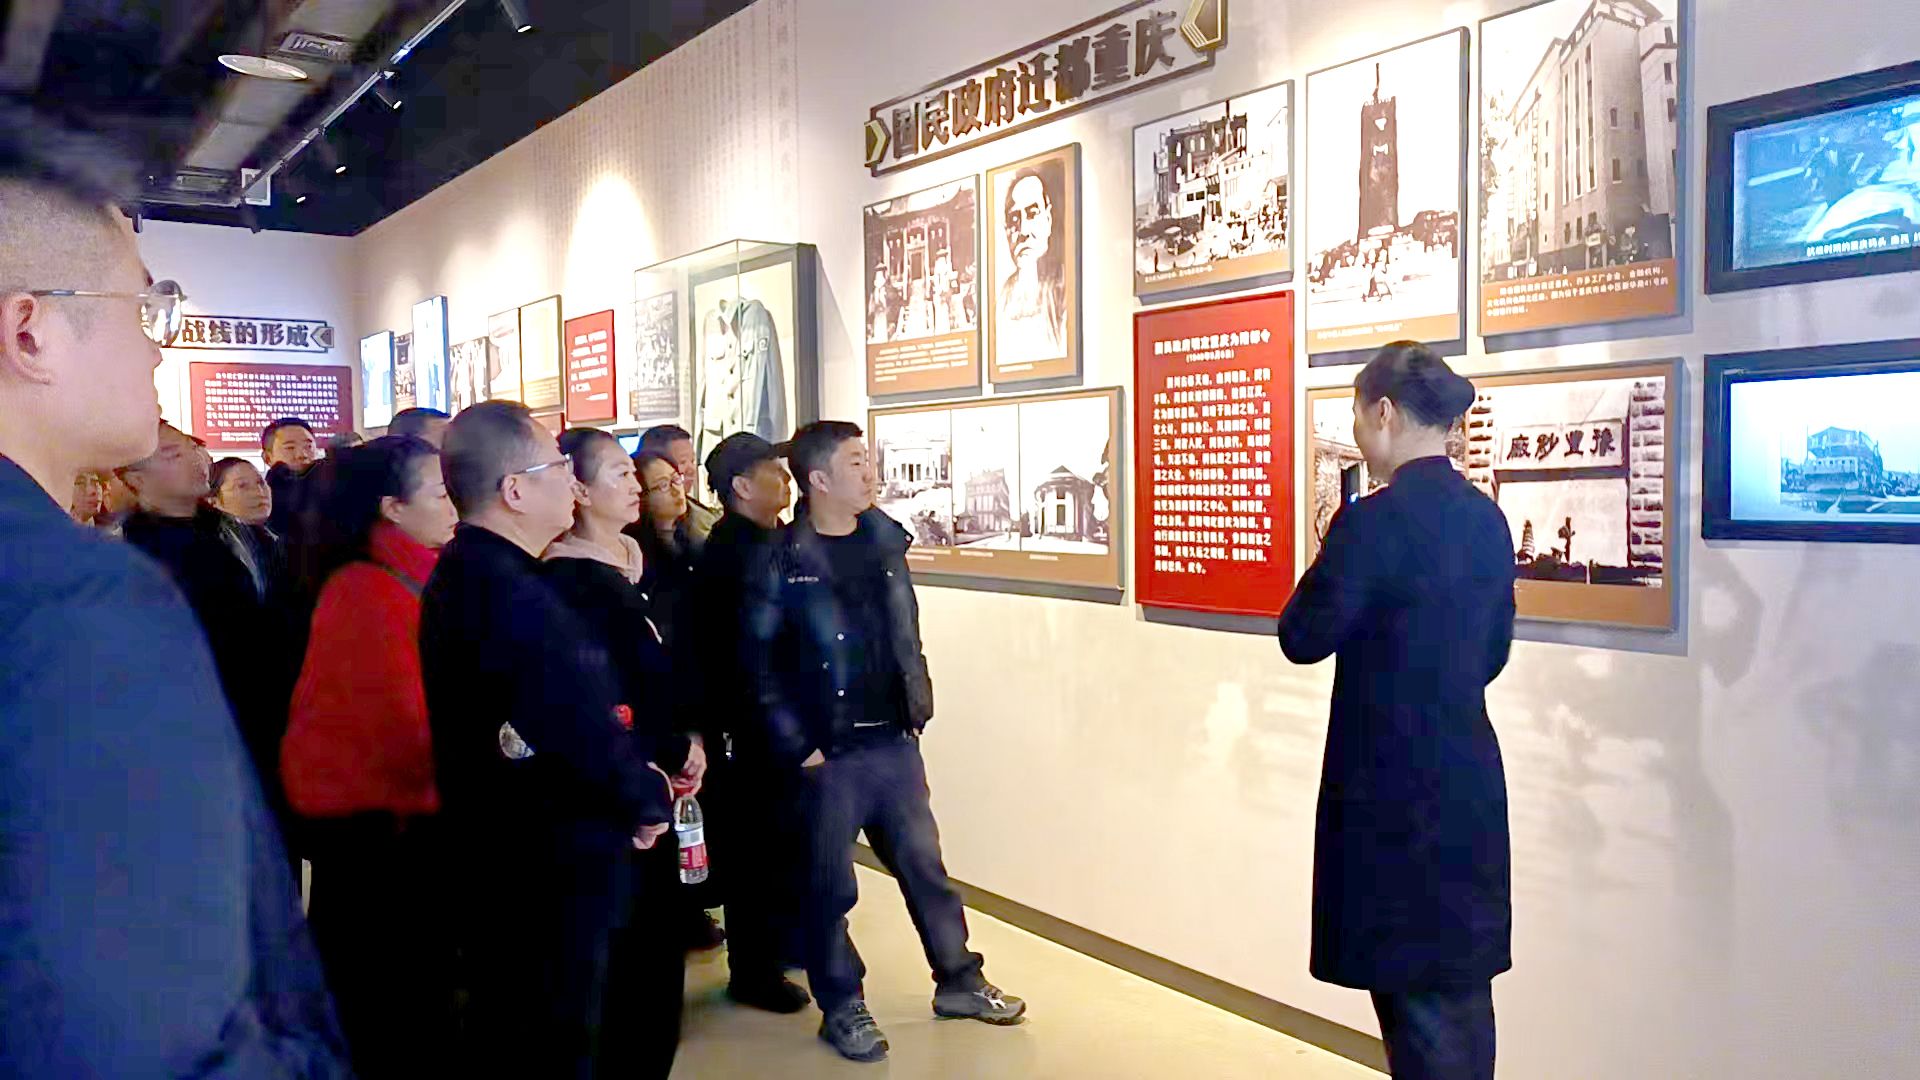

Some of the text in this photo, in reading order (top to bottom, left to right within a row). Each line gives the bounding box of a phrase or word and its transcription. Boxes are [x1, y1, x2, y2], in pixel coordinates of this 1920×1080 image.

[891, 10, 1177, 159] 国民政府迁都重庆
[181, 318, 310, 348] 战线的形成
